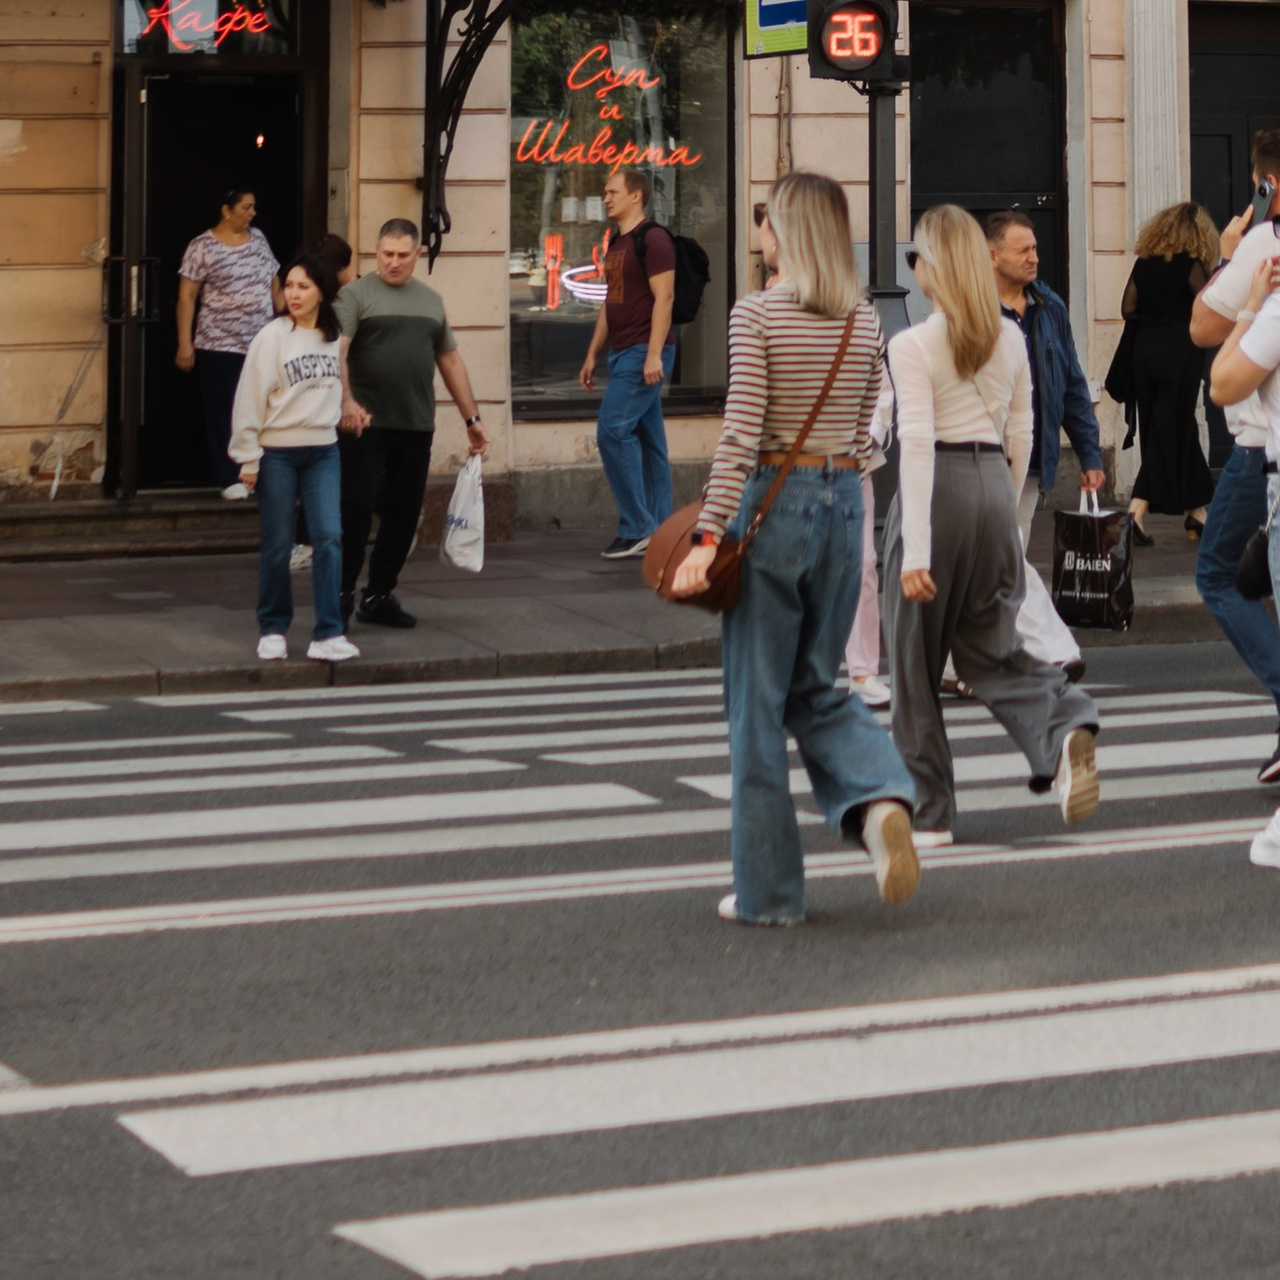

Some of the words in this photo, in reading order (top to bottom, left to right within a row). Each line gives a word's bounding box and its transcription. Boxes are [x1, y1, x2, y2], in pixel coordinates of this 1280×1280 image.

[830, 13, 878, 57] 26
[567, 44, 661, 99] Суп
[599, 104, 625, 121] и
[516, 118, 702, 179] Шаверма
